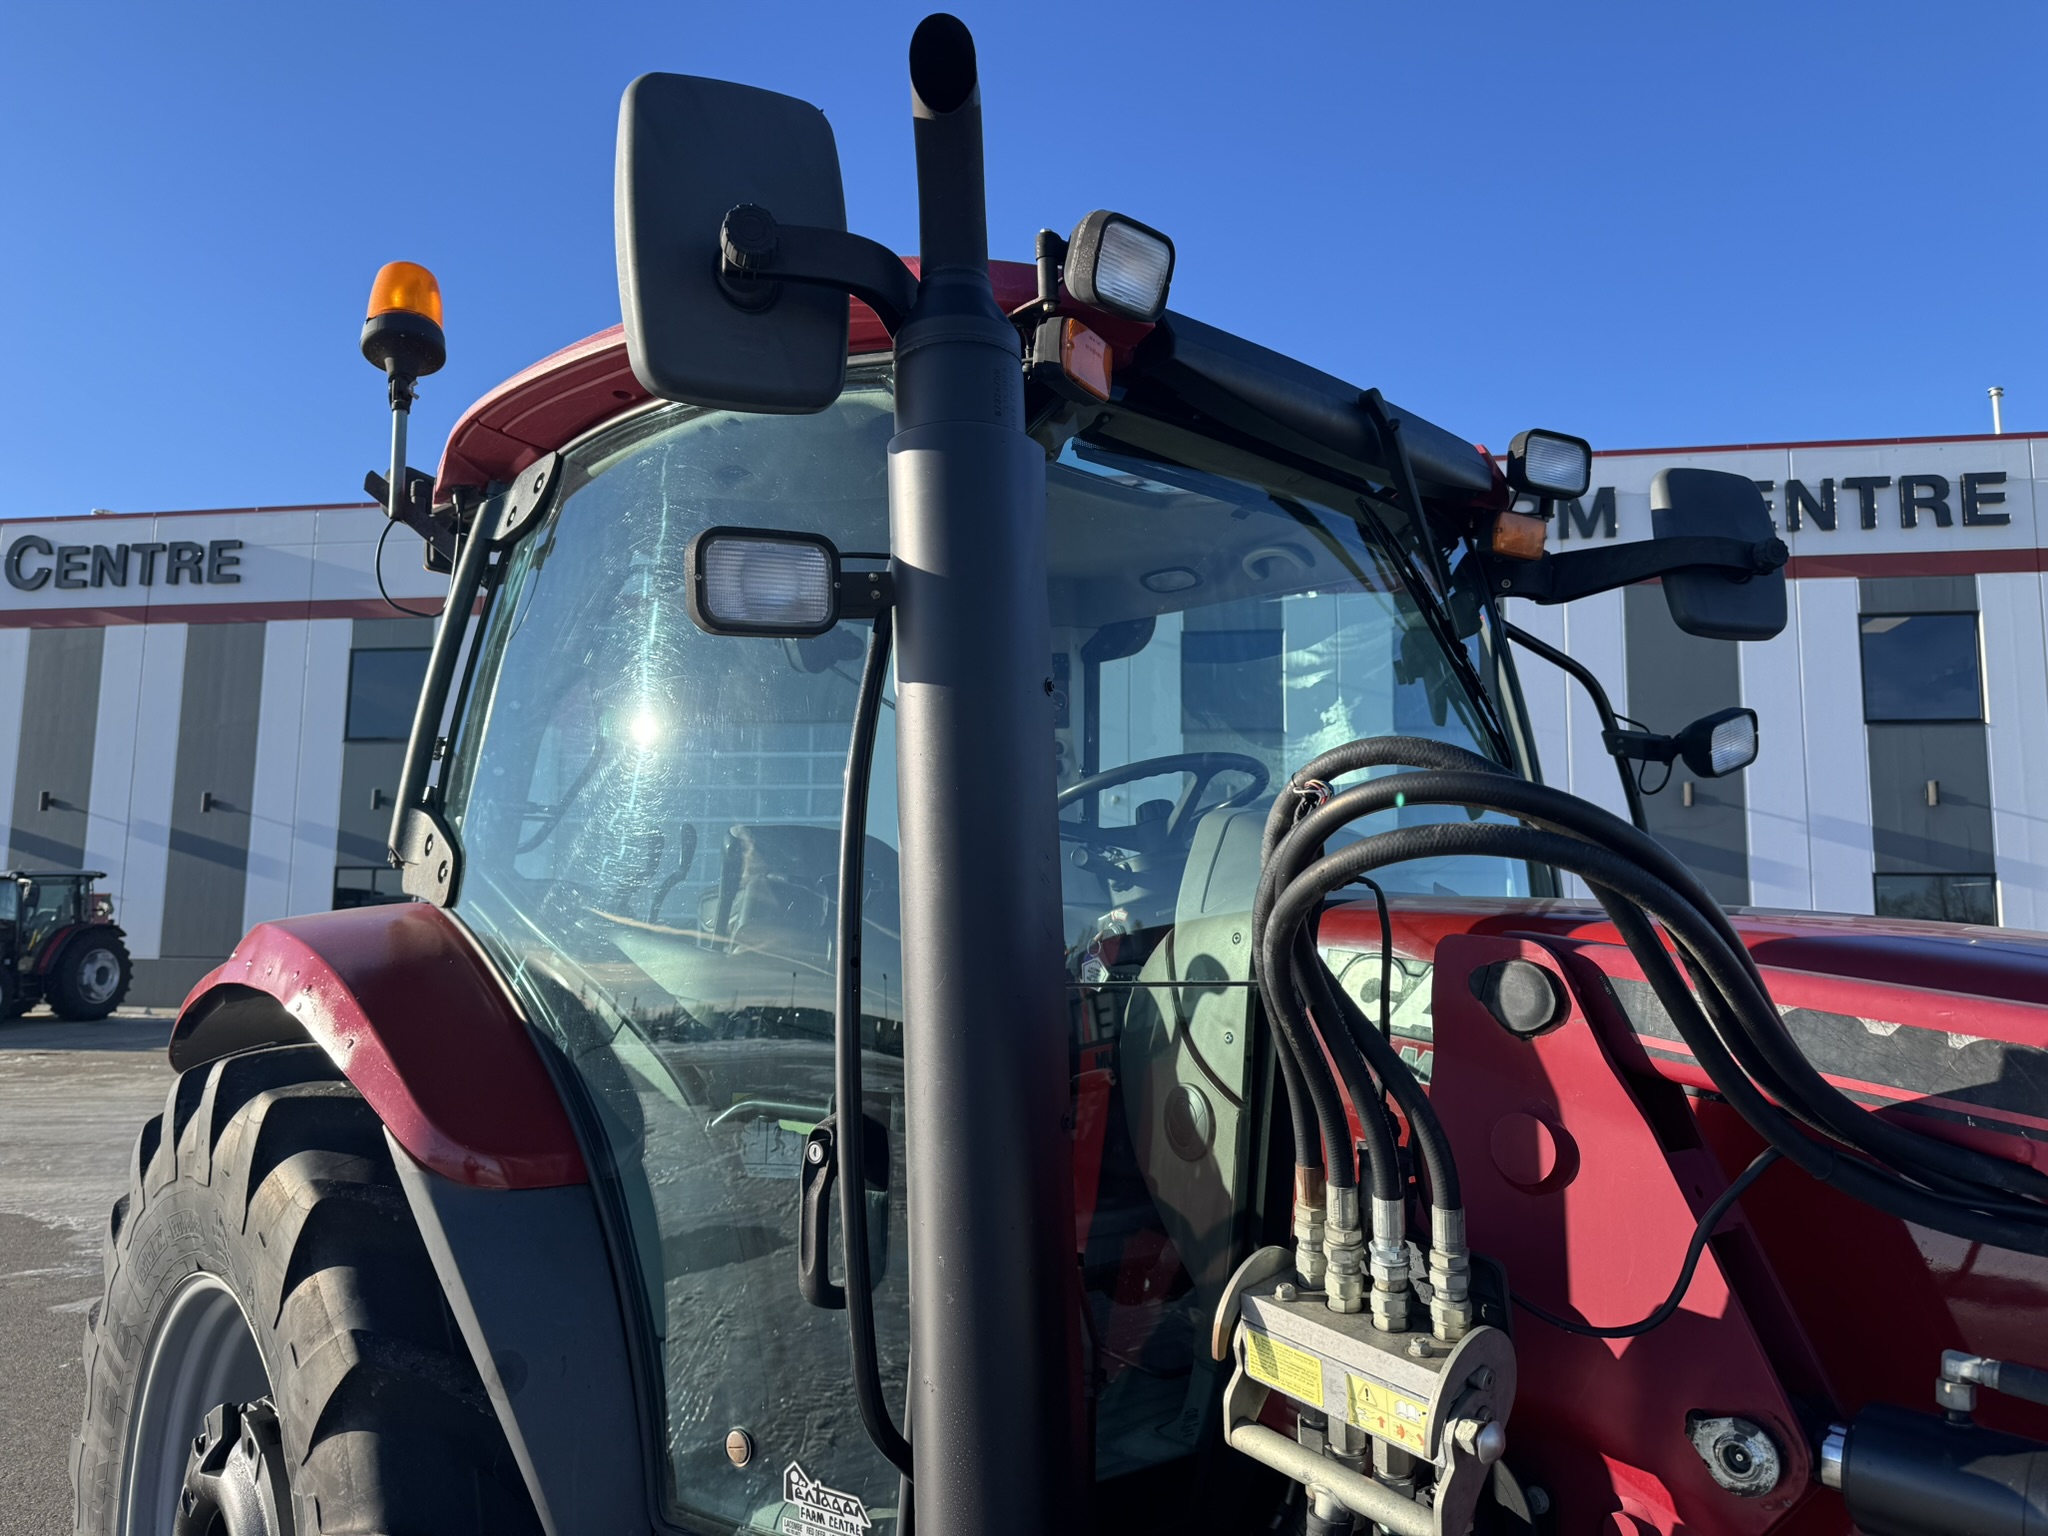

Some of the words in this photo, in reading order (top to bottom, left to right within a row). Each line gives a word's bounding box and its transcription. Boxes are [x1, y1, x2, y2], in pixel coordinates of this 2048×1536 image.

[1754, 471, 2011, 532] NTRE
[4, 534, 243, 591] CENTRE
[800, 1506, 826, 1526] FARM
